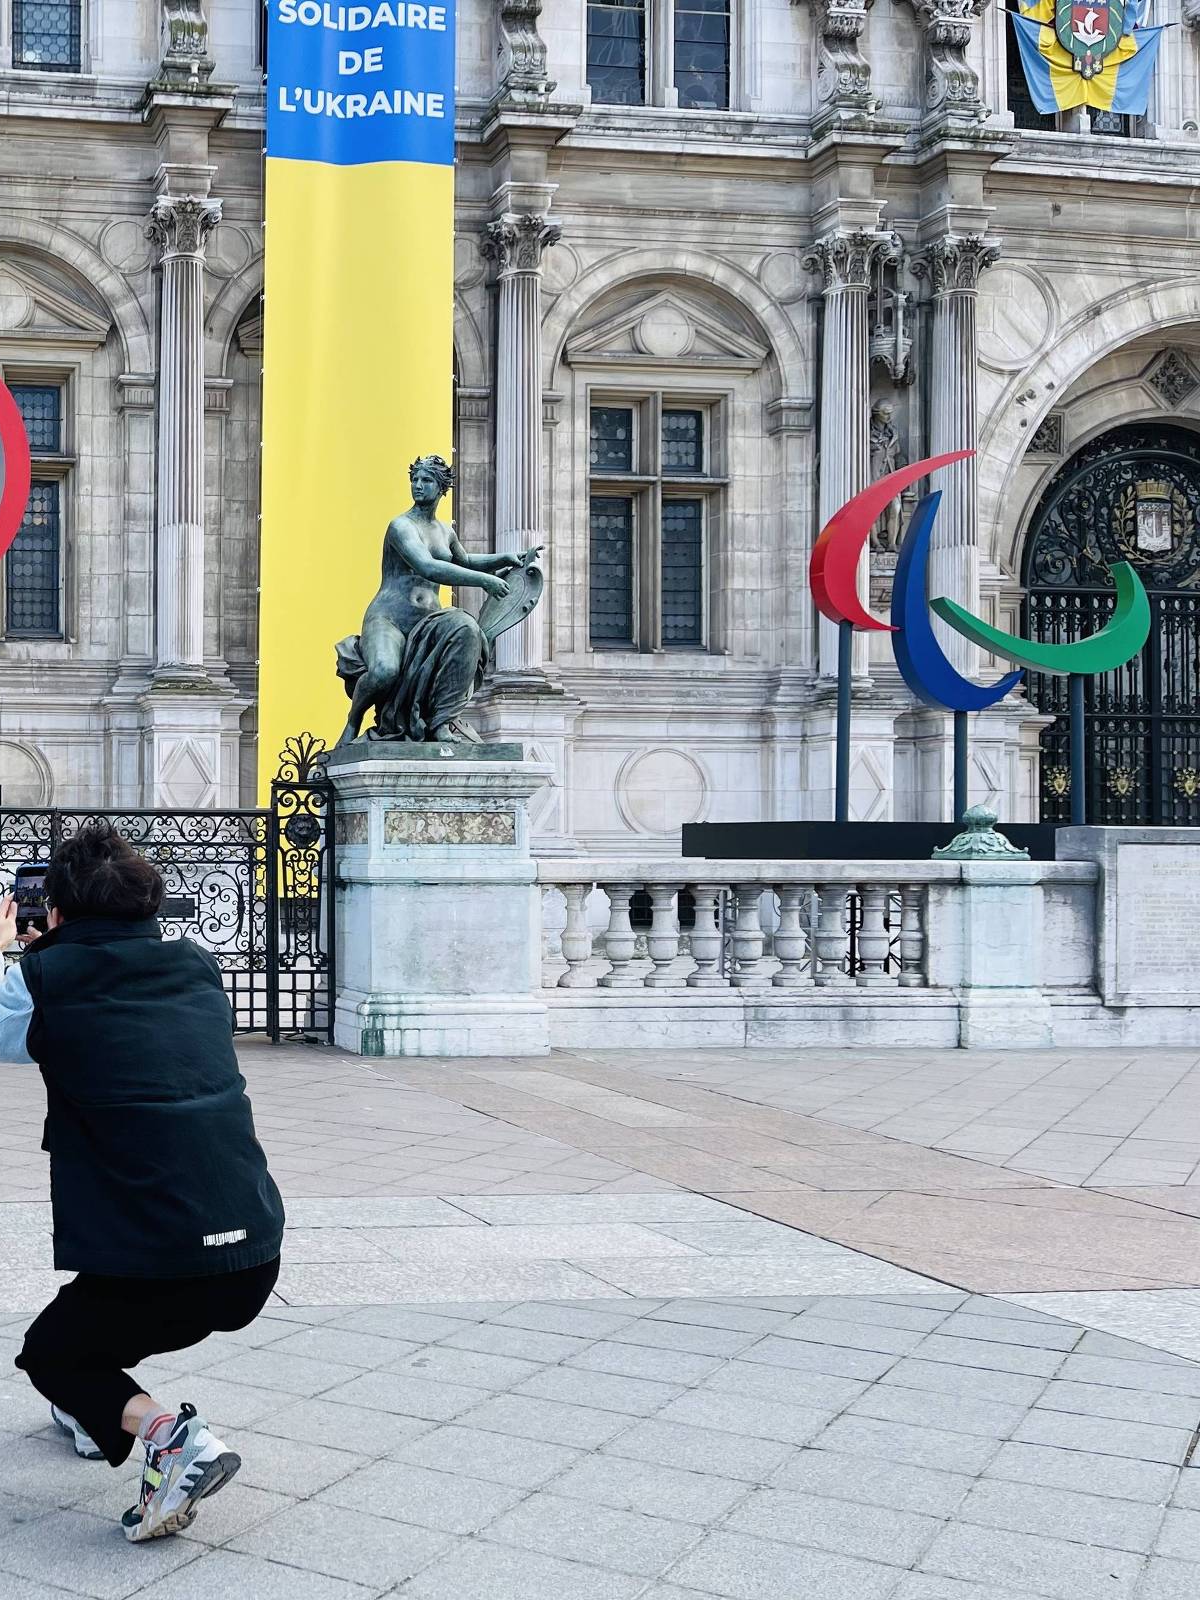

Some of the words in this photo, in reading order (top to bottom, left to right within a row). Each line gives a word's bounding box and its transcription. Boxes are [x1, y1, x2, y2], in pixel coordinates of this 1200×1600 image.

[278, 0, 447, 32] SOLIDAIRE
[338, 46, 384, 76] DE
[279, 86, 445, 119] L'UKRAINE
